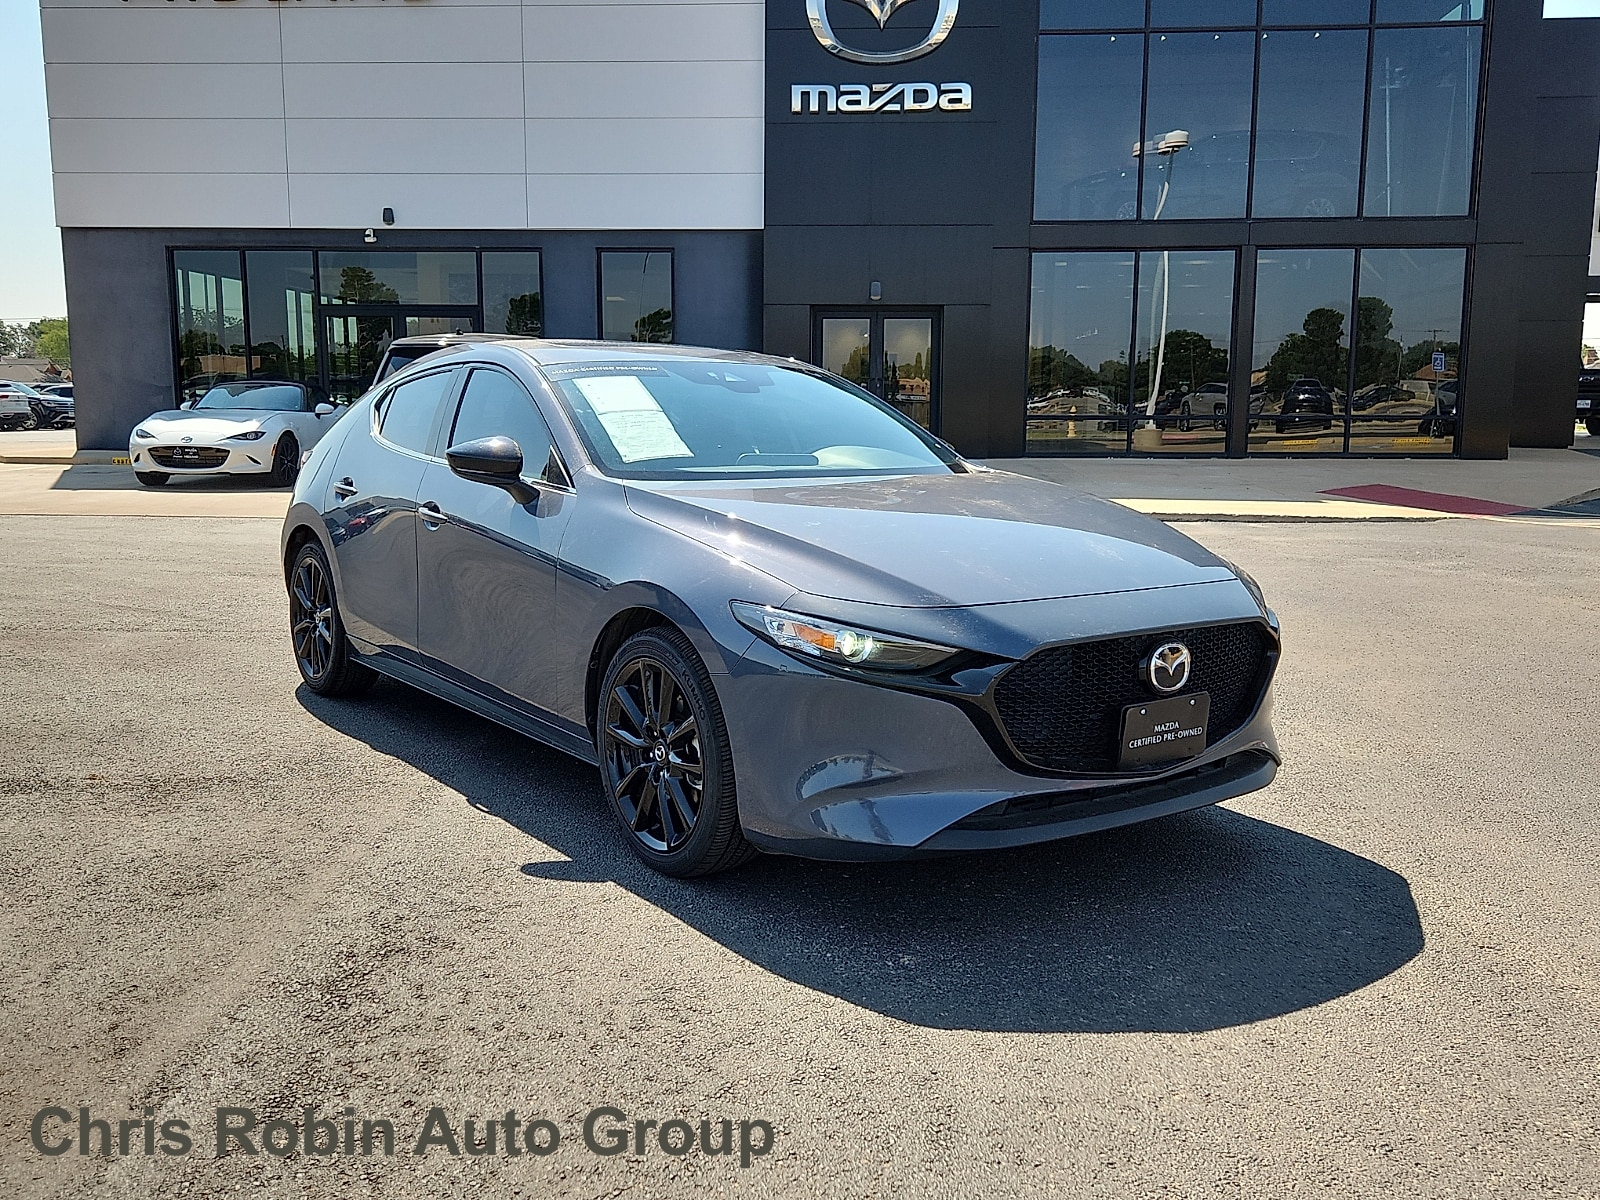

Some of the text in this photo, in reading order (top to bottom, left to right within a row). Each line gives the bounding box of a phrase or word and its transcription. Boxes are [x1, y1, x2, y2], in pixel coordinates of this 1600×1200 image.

[682, 669, 705, 720] KUMHO
[1129, 727, 1203, 748] CERTIFIED PRE-OWNED
[1154, 721, 1180, 733] MAZDA
